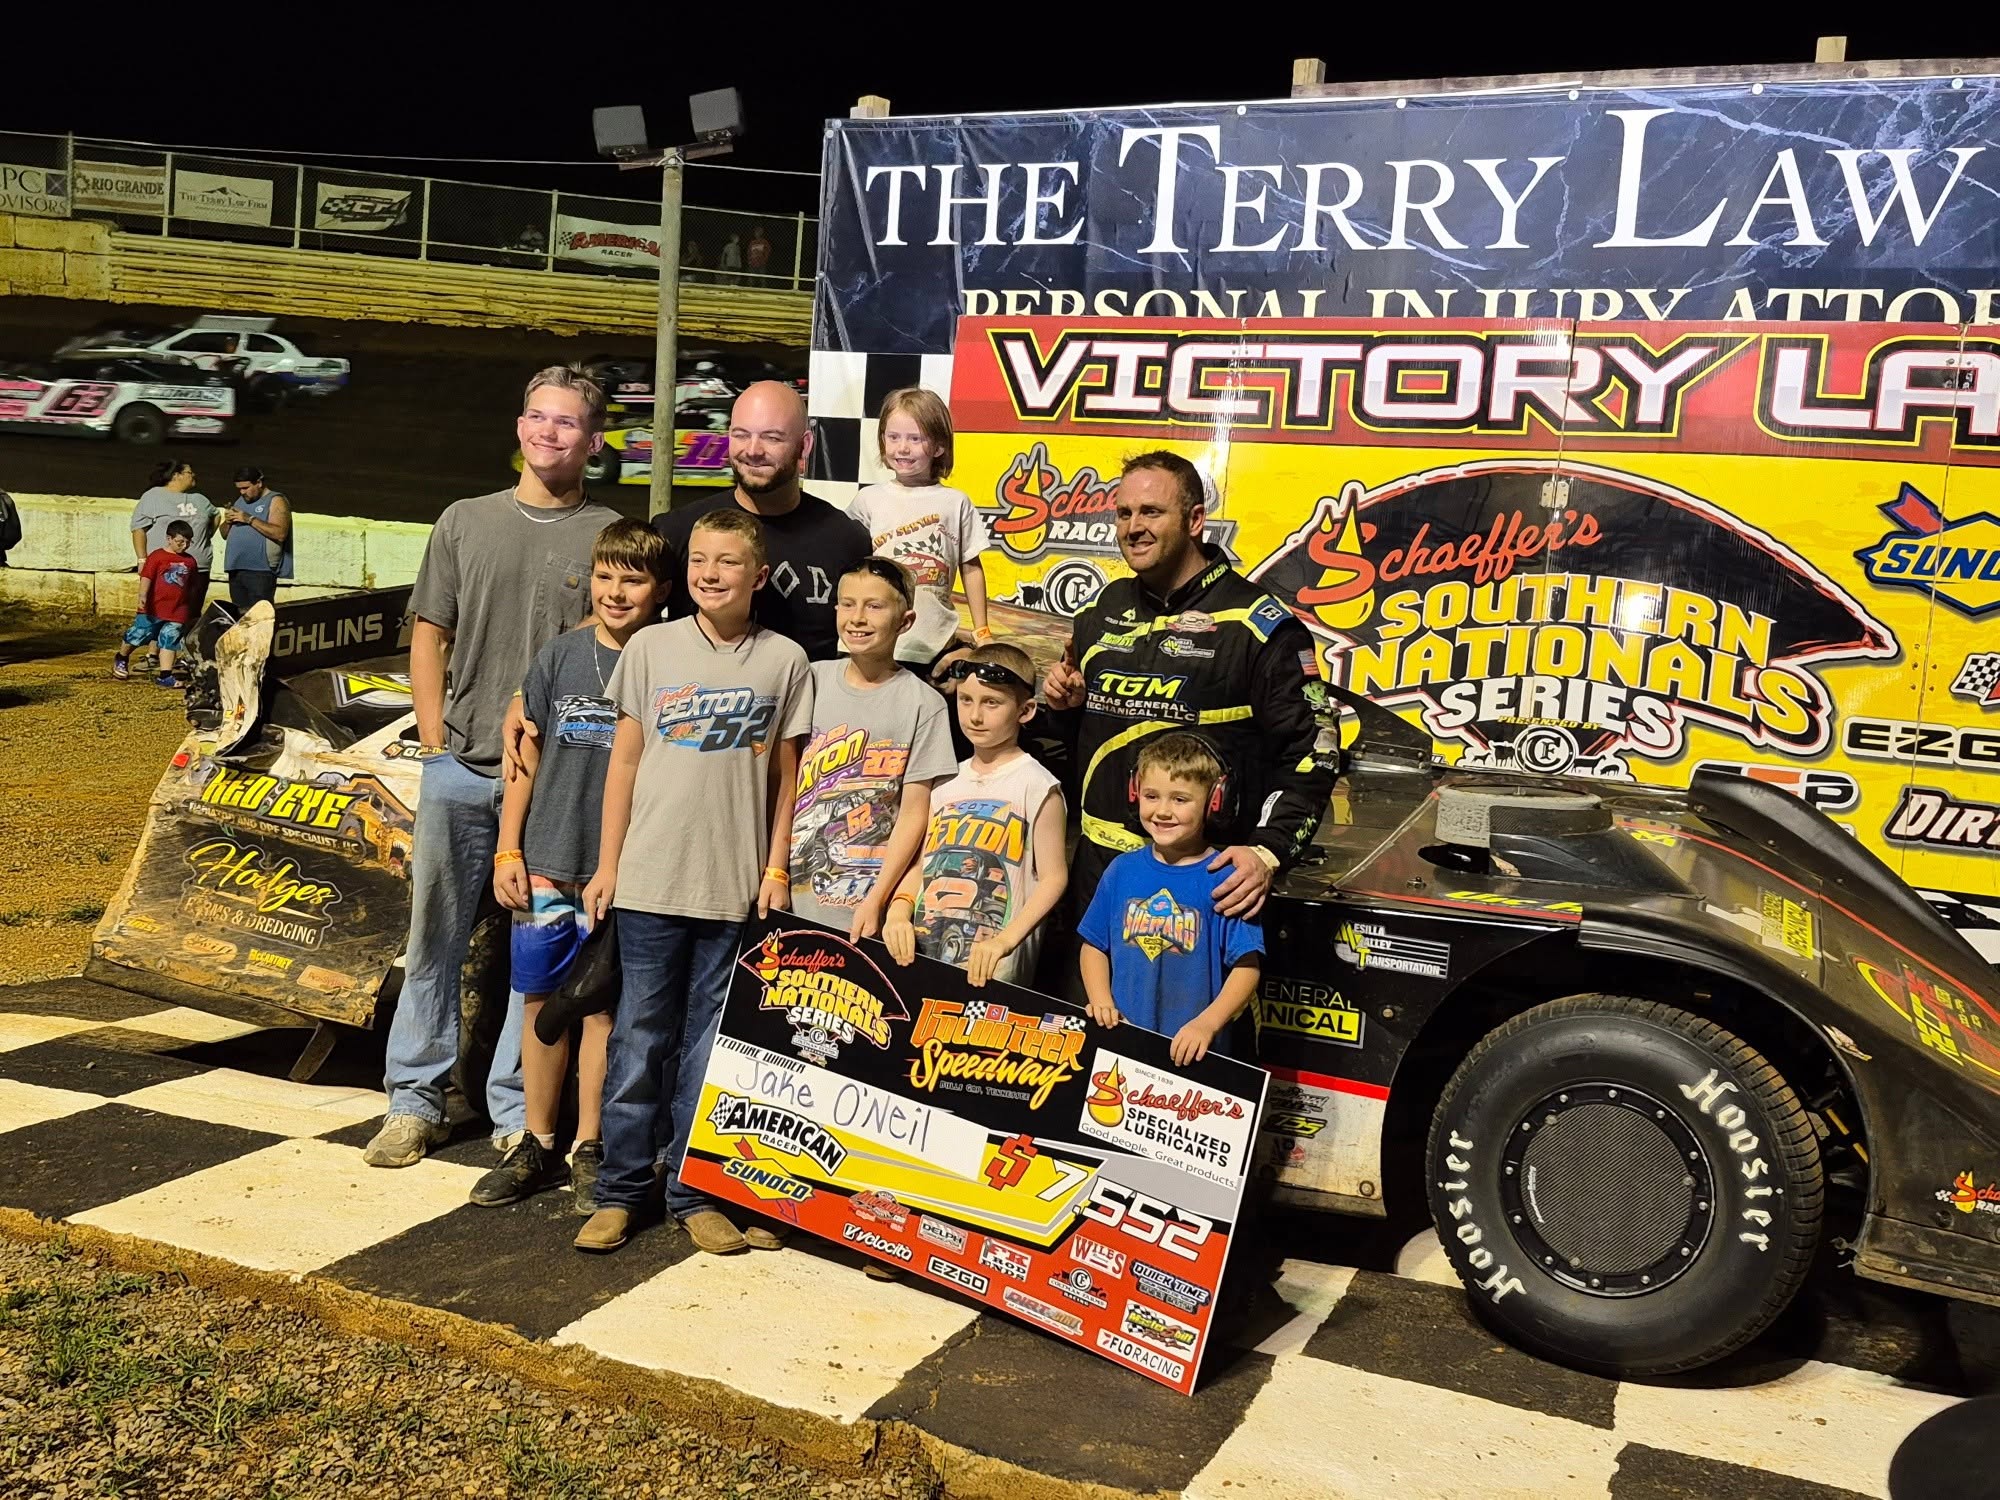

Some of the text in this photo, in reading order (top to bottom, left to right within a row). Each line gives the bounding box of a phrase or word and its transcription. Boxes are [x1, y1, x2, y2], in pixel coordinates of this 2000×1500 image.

[0, 167, 42, 193] PC
[91, 178, 164, 195] RIO GRANDE
[865, 108, 1986, 253] THE TERRY LAW
[569, 231, 660, 257] AMERICA
[600, 249, 633, 258] RACER
[996, 334, 1730, 430] VICTORY
[1297, 510, 1602, 605] Schaeffer's
[273, 613, 383, 657] ÖHLINS
[1380, 572, 1776, 666] SOUTHERN
[1099, 673, 1182, 698] TGM
[1347, 625, 1811, 737] NATIONALS
[659, 690, 752, 724] SEXTON
[1088, 692, 1188, 713] TEXAS GENERAL
[1163, 710, 1196, 721] LLC
[1437, 674, 1673, 750] SERIES
[1497, 715, 1602, 731] PRESENTED BY
[700, 704, 776, 752] 52
[269, 783, 357, 829] EYE
[947, 802, 1001, 812] SCOTT
[190, 843, 336, 913] Hodges
[231, 909, 245, 925] &
[246, 911, 318, 945] DREDGING
[755, 940, 847, 973] Schaeffer's
[1356, 947, 1441, 976] TRANSPORTATION
[776, 969, 885, 1019] SOUTHERN
[1263, 980, 1360, 1012] ENERAL
[764, 985, 890, 1045] NATIONALS
[788, 1006, 855, 1043] SERIES
[910, 998, 1087, 1071] VOLUNTEER
[1262, 1007, 1354, 1036] NICAL
[716, 1037, 807, 1074] FEATURE WINNER
[910, 1038, 1073, 1110] Speedway
[1134, 1067, 1157, 1081] SINCE
[735, 1056, 932, 1152] Jake O'Neil
[1087, 1071, 1245, 1121] Schaeffer's
[724, 1101, 843, 1170] AMERICAN
[761, 1134, 798, 1152] RACER
[1124, 1121, 1228, 1168] LUBRICANTS
[1127, 1107, 1232, 1155] SPECIALIZED
[1081, 1122, 1238, 1189] Good people. Great products.
[1678, 1068, 1784, 1252] Hoosier
[725, 1159, 810, 1200] SUNOCO
[1437, 1130, 1527, 1303] Hoosier
[992, 1256, 1026, 1274] ROD
[1075, 1235, 1125, 1274] WILES
[1134, 1263, 1173, 1287] QUICK
[1173, 1279, 1208, 1302] TIME
